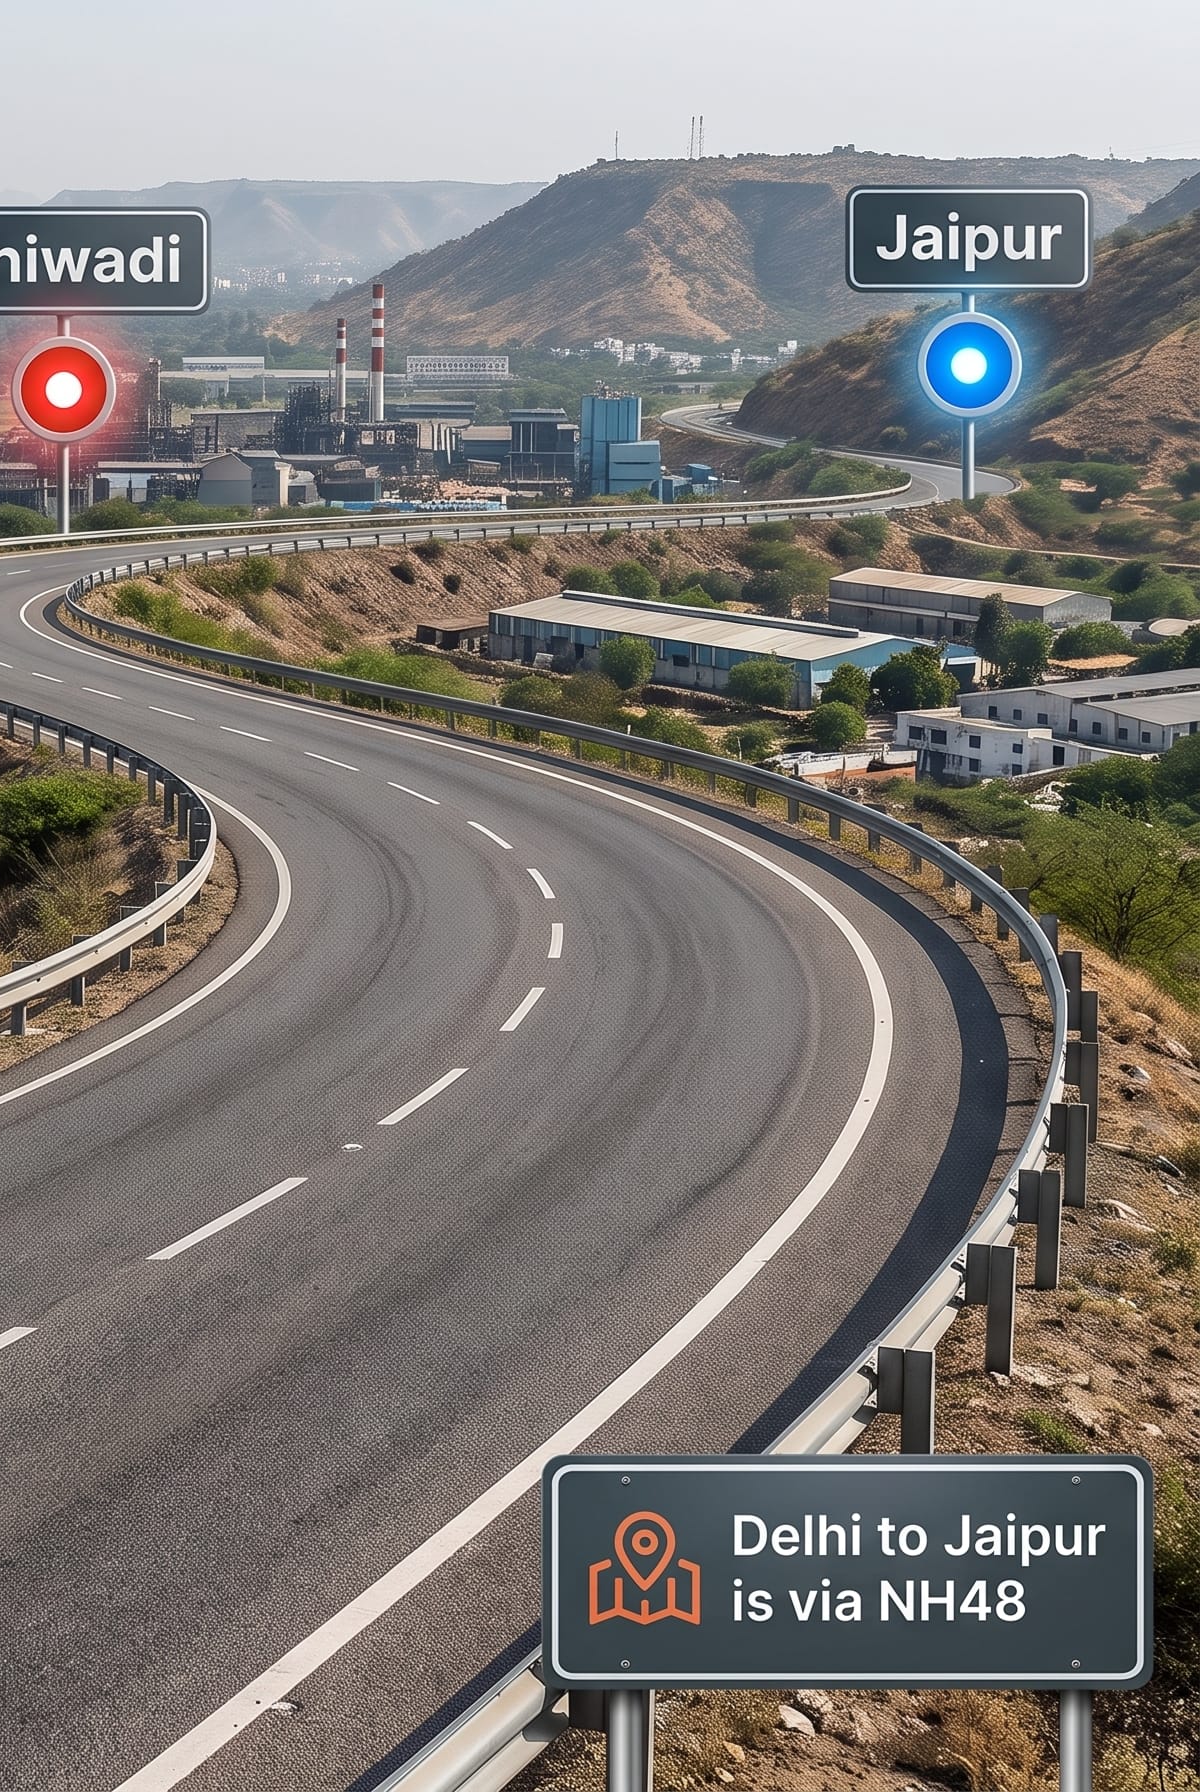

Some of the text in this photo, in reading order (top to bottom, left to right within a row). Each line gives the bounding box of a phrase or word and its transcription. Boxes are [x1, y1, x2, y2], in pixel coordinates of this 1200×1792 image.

[877, 211, 1063, 272] Jaipur
[733, 1512, 1106, 1567] Delhi to Jaipur
[733, 1578, 1026, 1622] is via NH48
